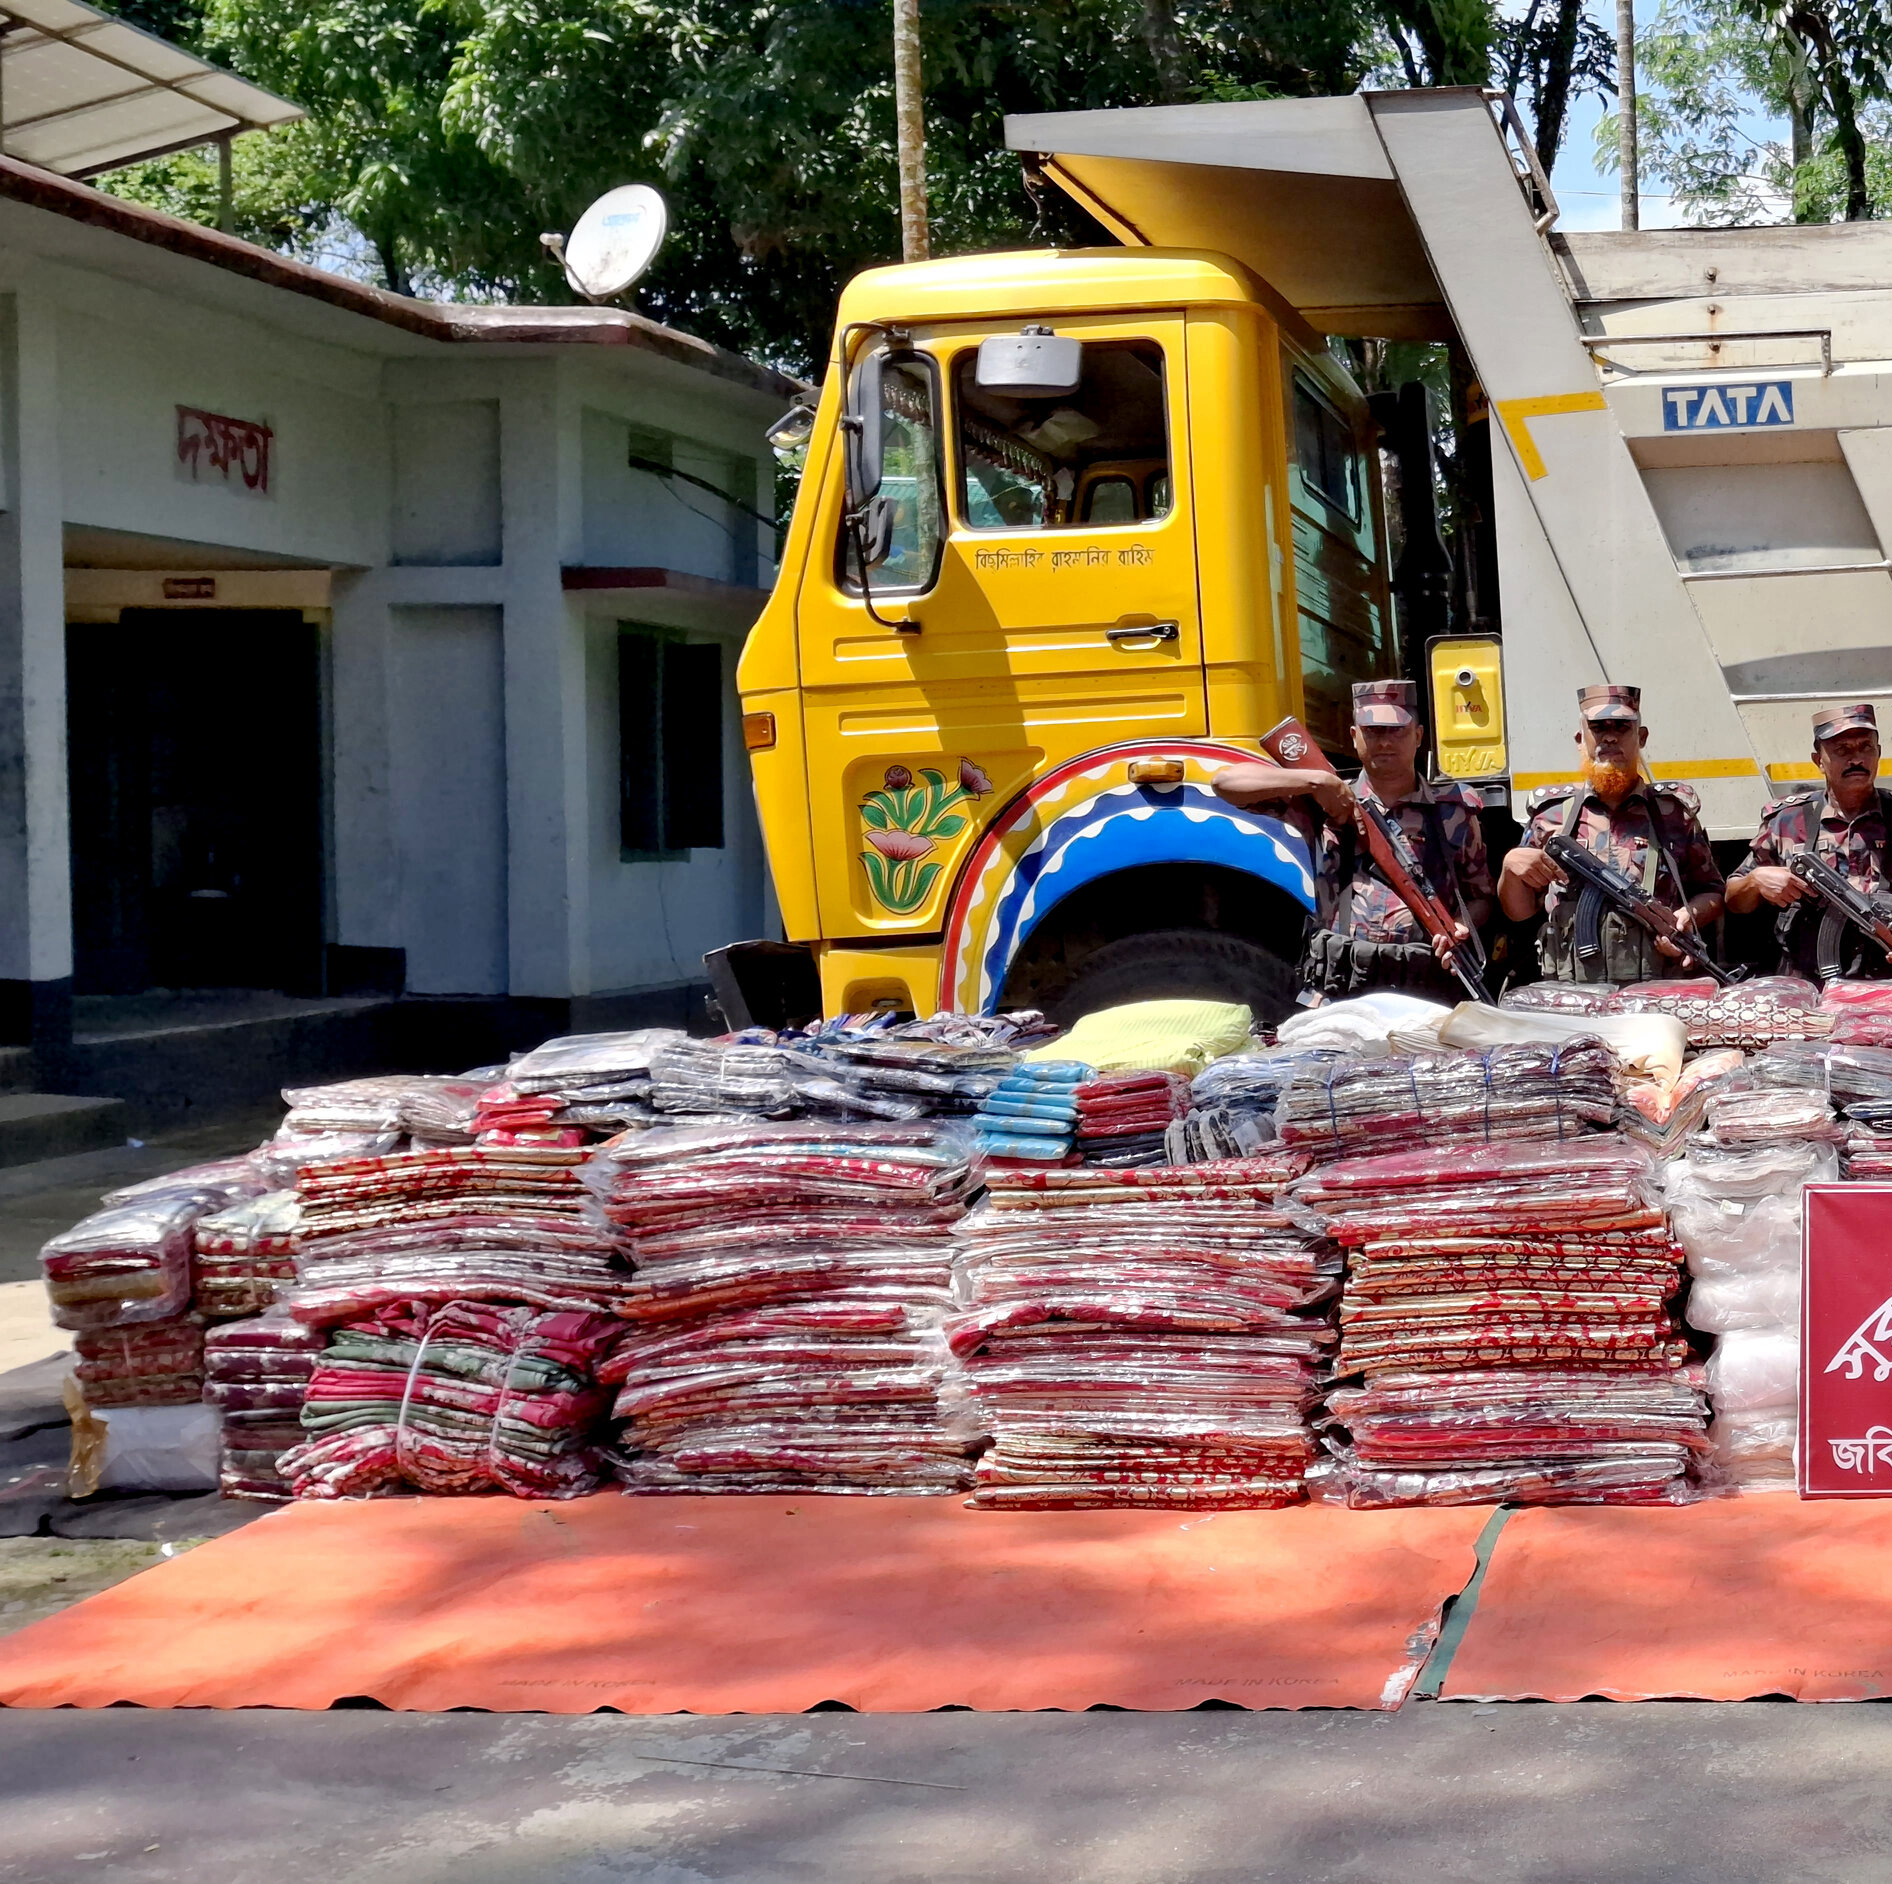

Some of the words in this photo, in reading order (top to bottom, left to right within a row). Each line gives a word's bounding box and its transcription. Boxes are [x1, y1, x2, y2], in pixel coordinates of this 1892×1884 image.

[1666, 386, 1792, 427] TATA
[174, 404, 274, 495] দক্ষতা
[1456, 701, 1483, 713] HYVA
[1444, 745, 1502, 772] HYVA
[1814, 1669, 1884, 1678] KOREA
